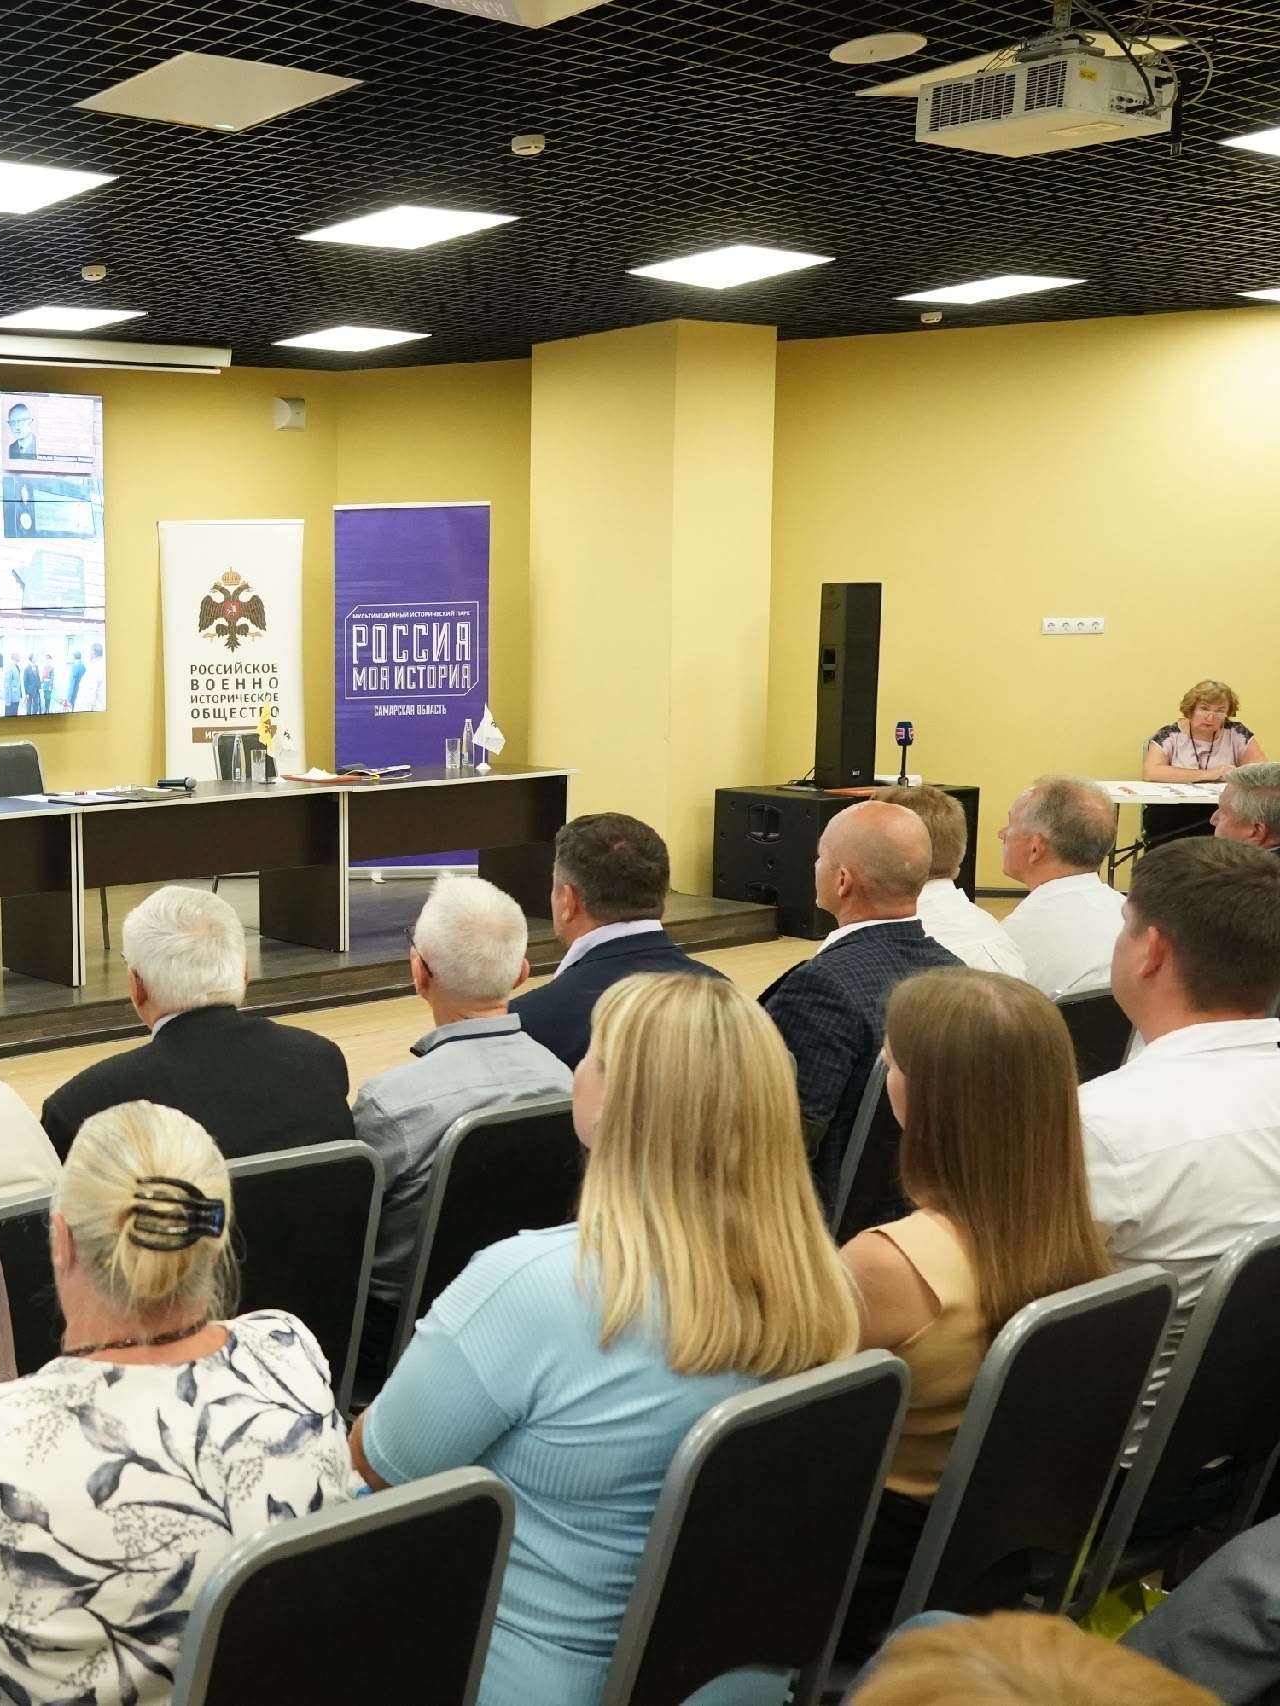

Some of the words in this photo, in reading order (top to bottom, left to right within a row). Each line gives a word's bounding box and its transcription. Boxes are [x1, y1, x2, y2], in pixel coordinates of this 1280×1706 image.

[352, 621, 471, 664] РОССИЯ
[190, 662, 278, 675] РОССИЙСКОЕ
[190, 676, 279, 691] ВОЕННО
[352, 666, 390, 691] МОЯ
[394, 663, 471, 690] ИСТОРИЯ
[374, 704, 415, 716] САМАРСКАЯ
[416, 704, 447, 715] ОБЛАСТЬ
